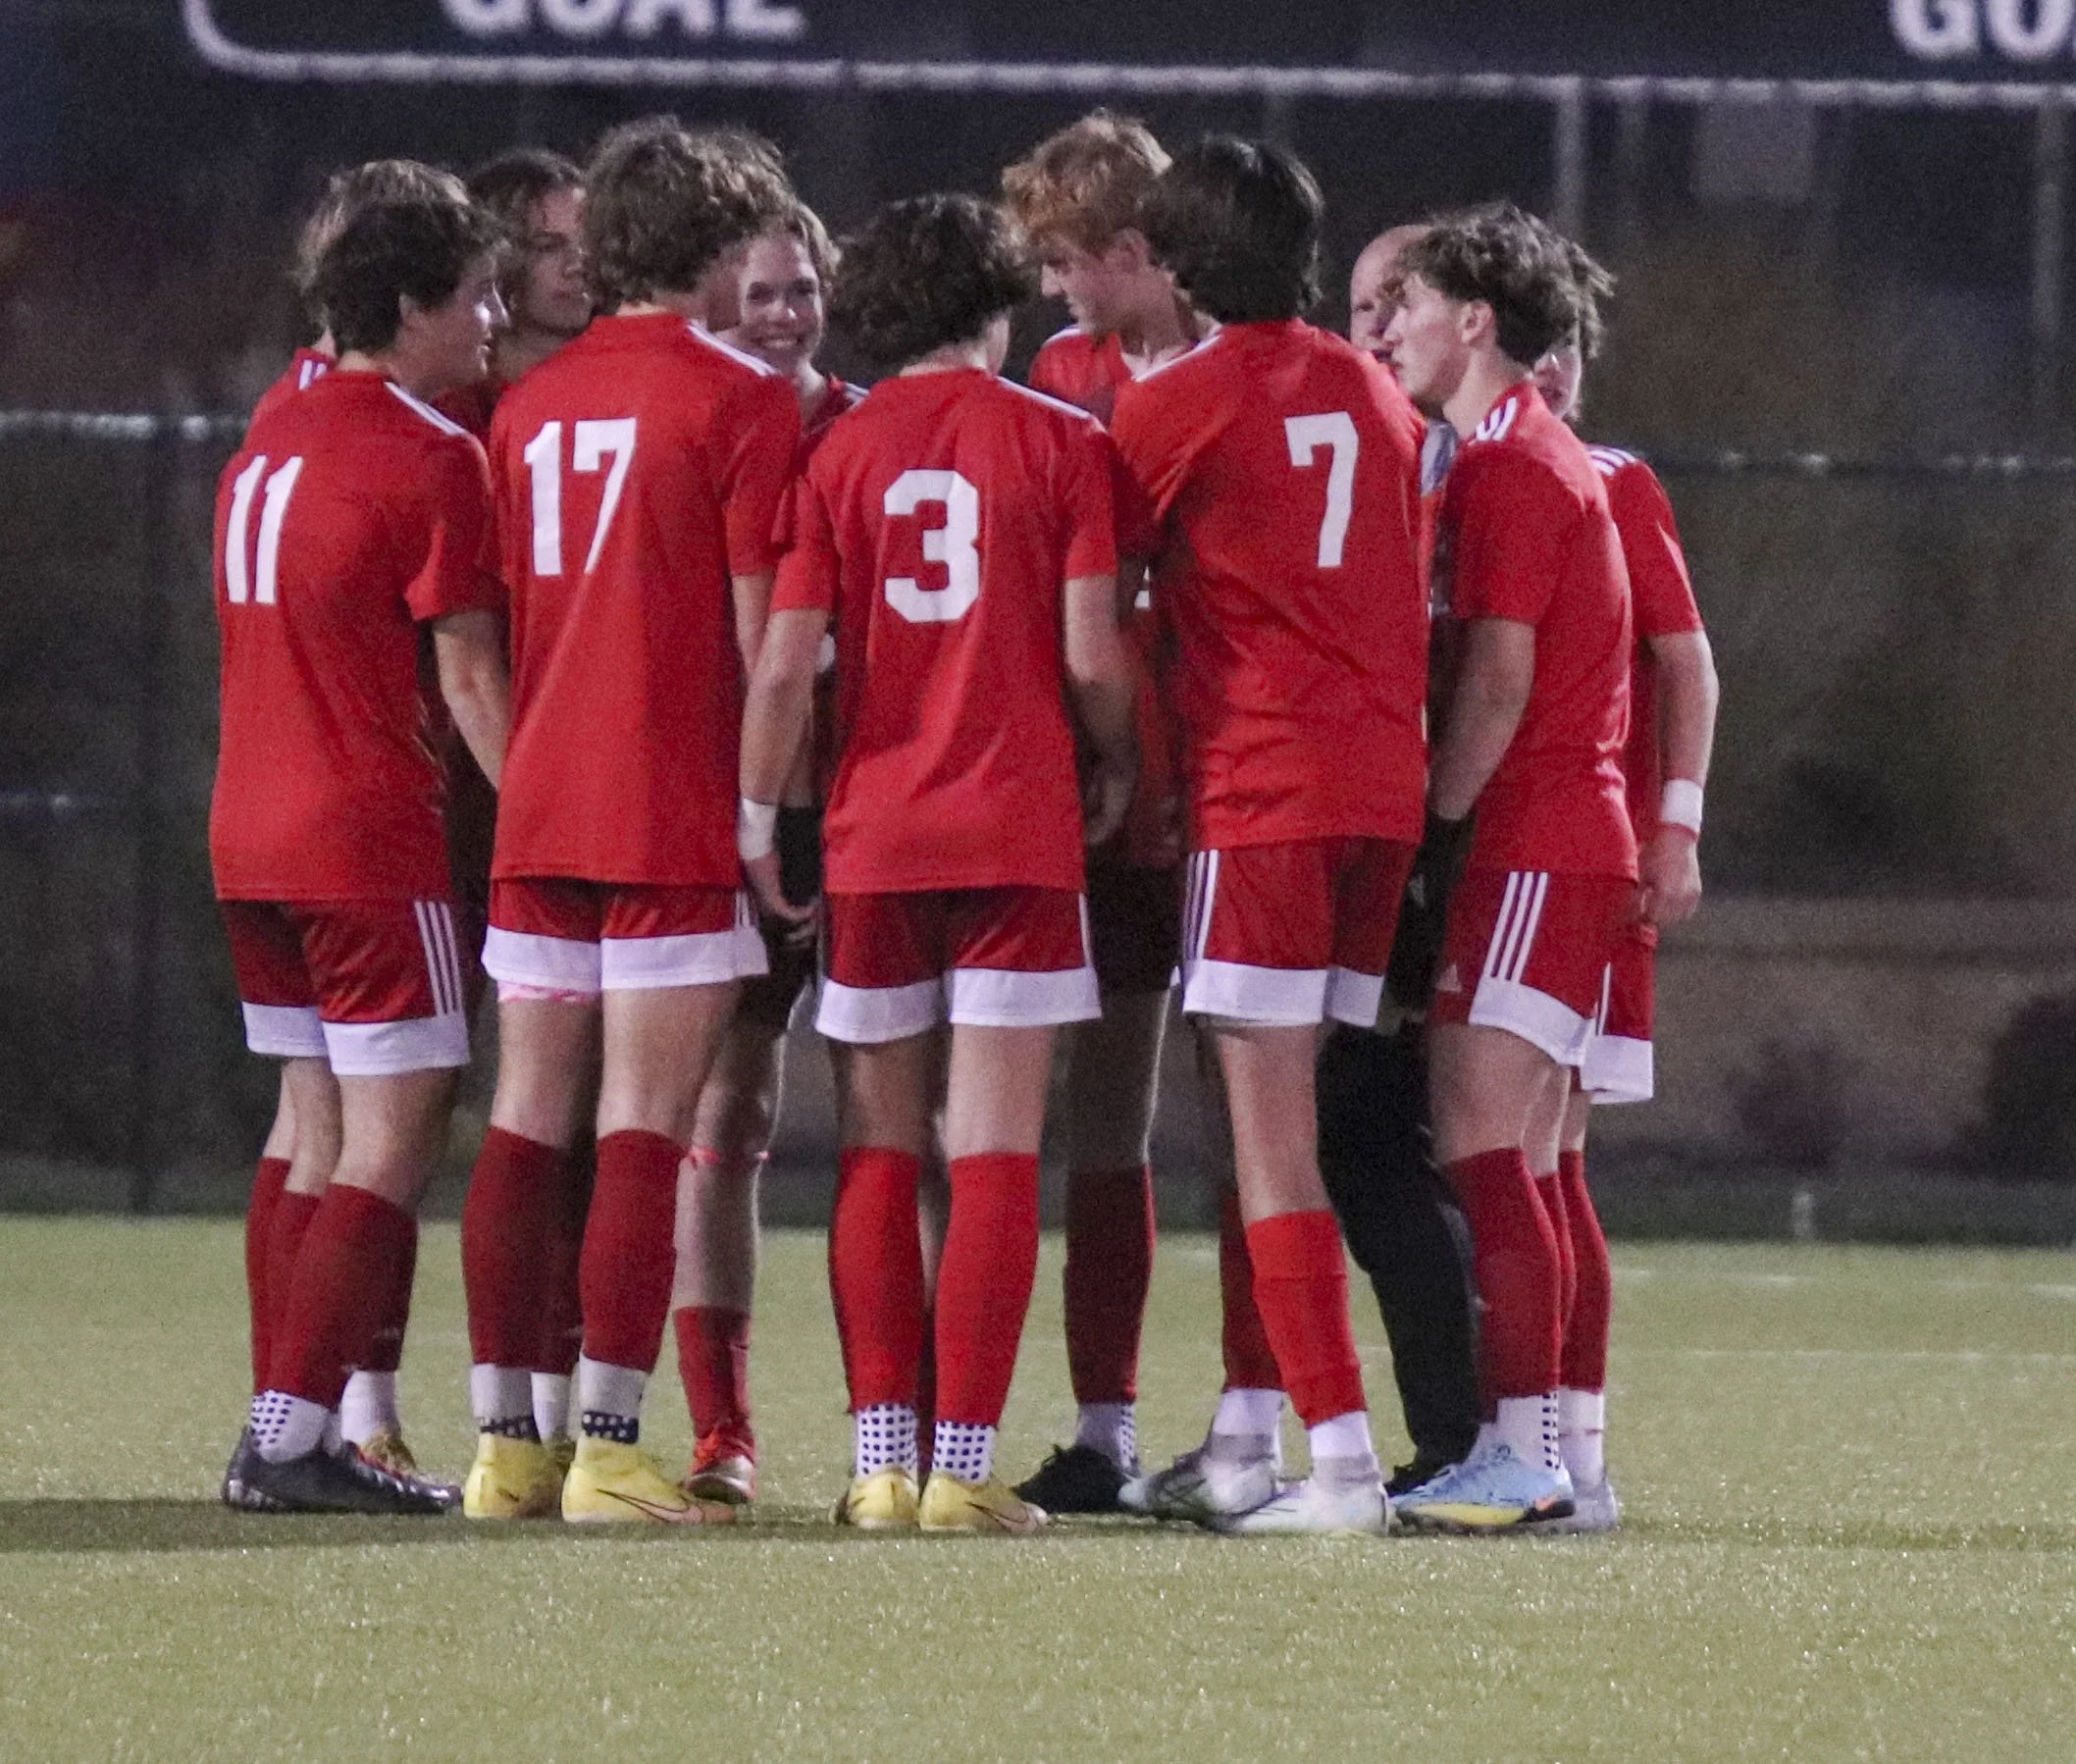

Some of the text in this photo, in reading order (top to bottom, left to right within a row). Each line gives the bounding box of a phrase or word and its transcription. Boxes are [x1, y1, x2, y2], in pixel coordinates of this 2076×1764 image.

[225, 454, 304, 605] 11
[524, 417, 638, 576] 17
[884, 469, 979, 624] 3
[1284, 411, 1359, 569] 7
